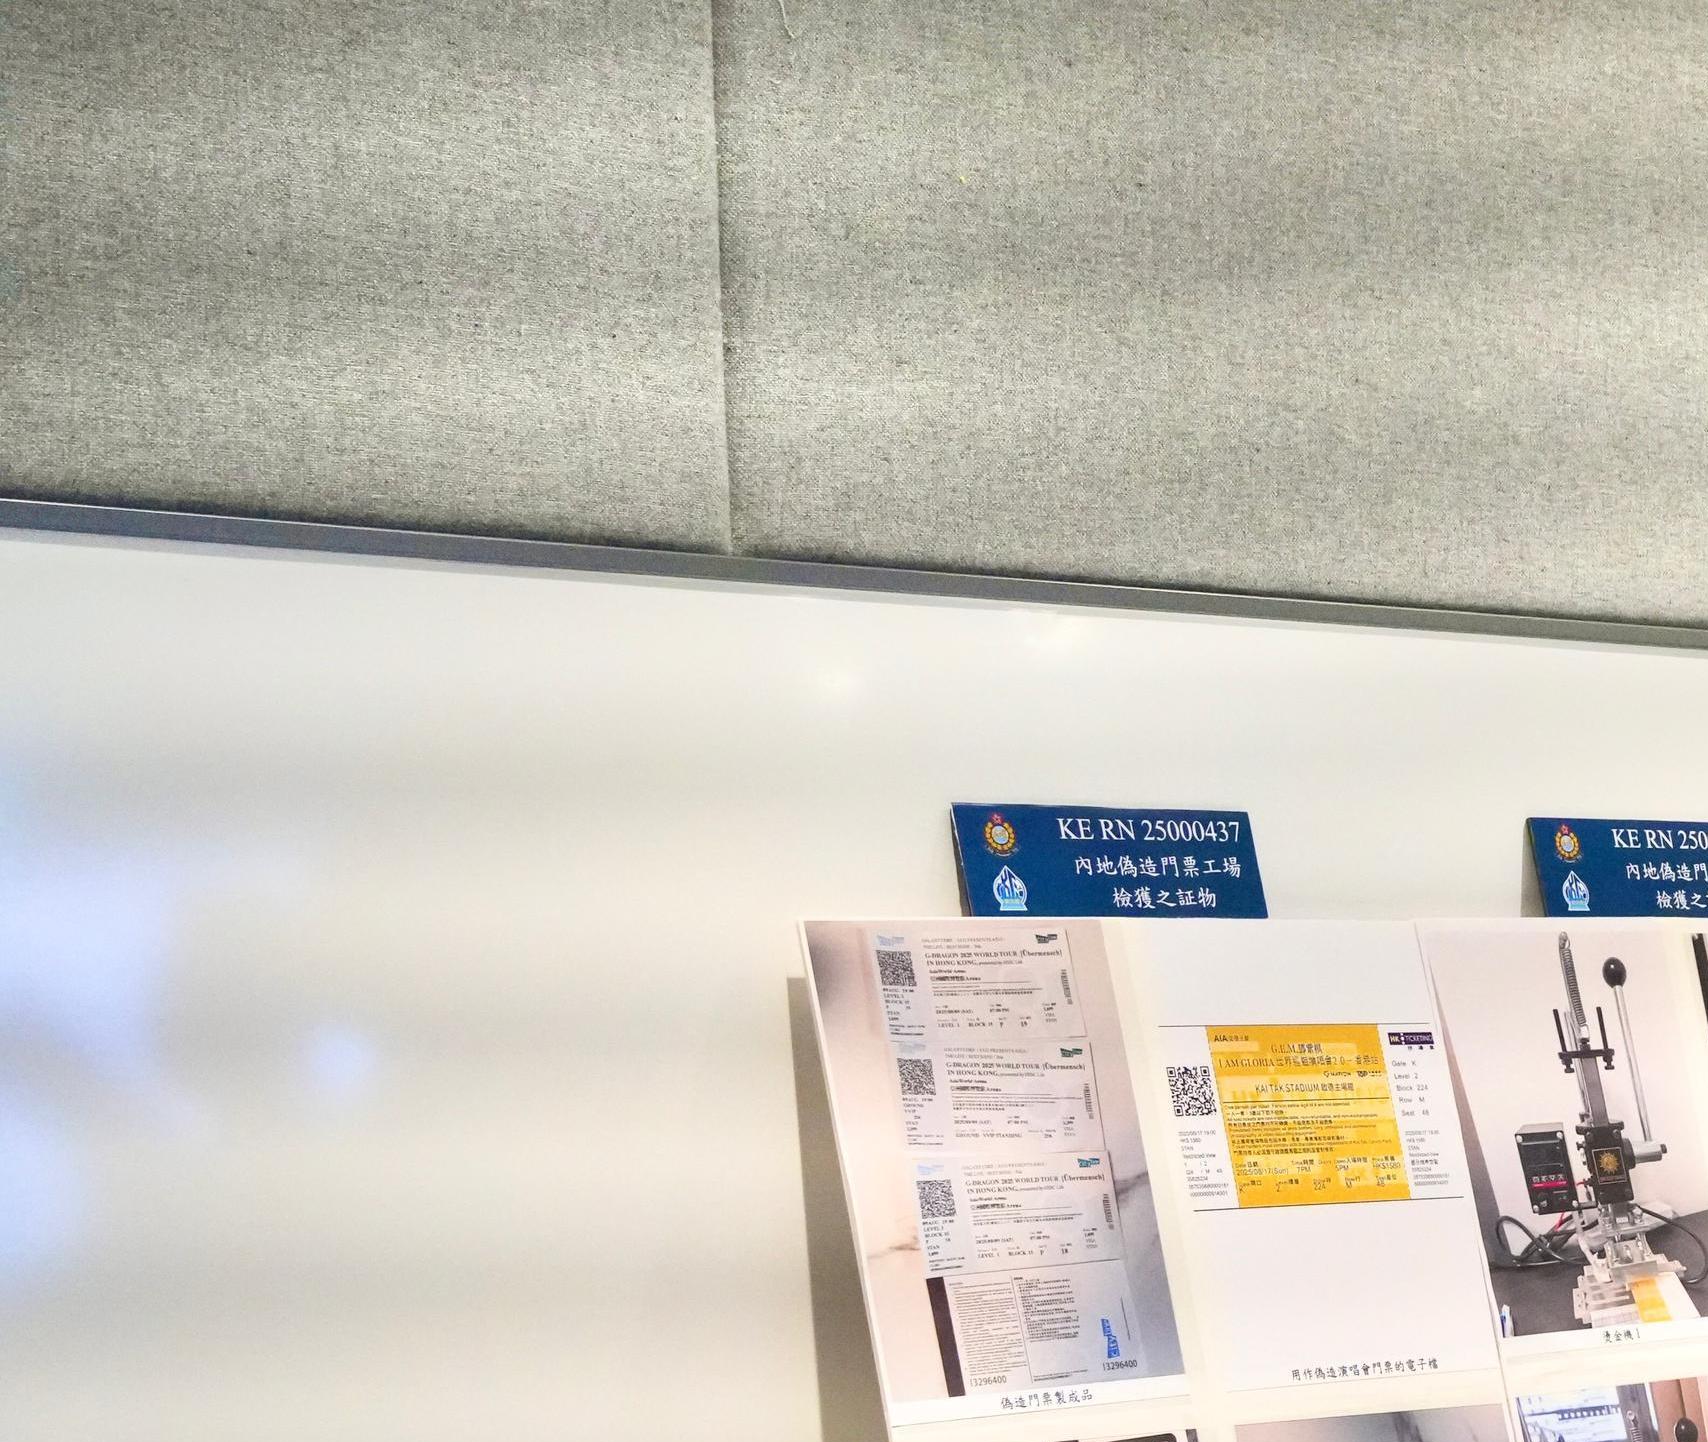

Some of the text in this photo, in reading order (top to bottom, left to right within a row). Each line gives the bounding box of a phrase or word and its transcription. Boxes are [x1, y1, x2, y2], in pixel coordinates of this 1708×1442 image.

[1056, 818, 1240, 843] KE RN 25000437
[1611, 829, 1641, 849] KE
[1647, 830, 1673, 850] RN
[1112, 887, 1216, 909] 檢獲之証物
[1285, 1083, 1320, 1092] STADIUM
